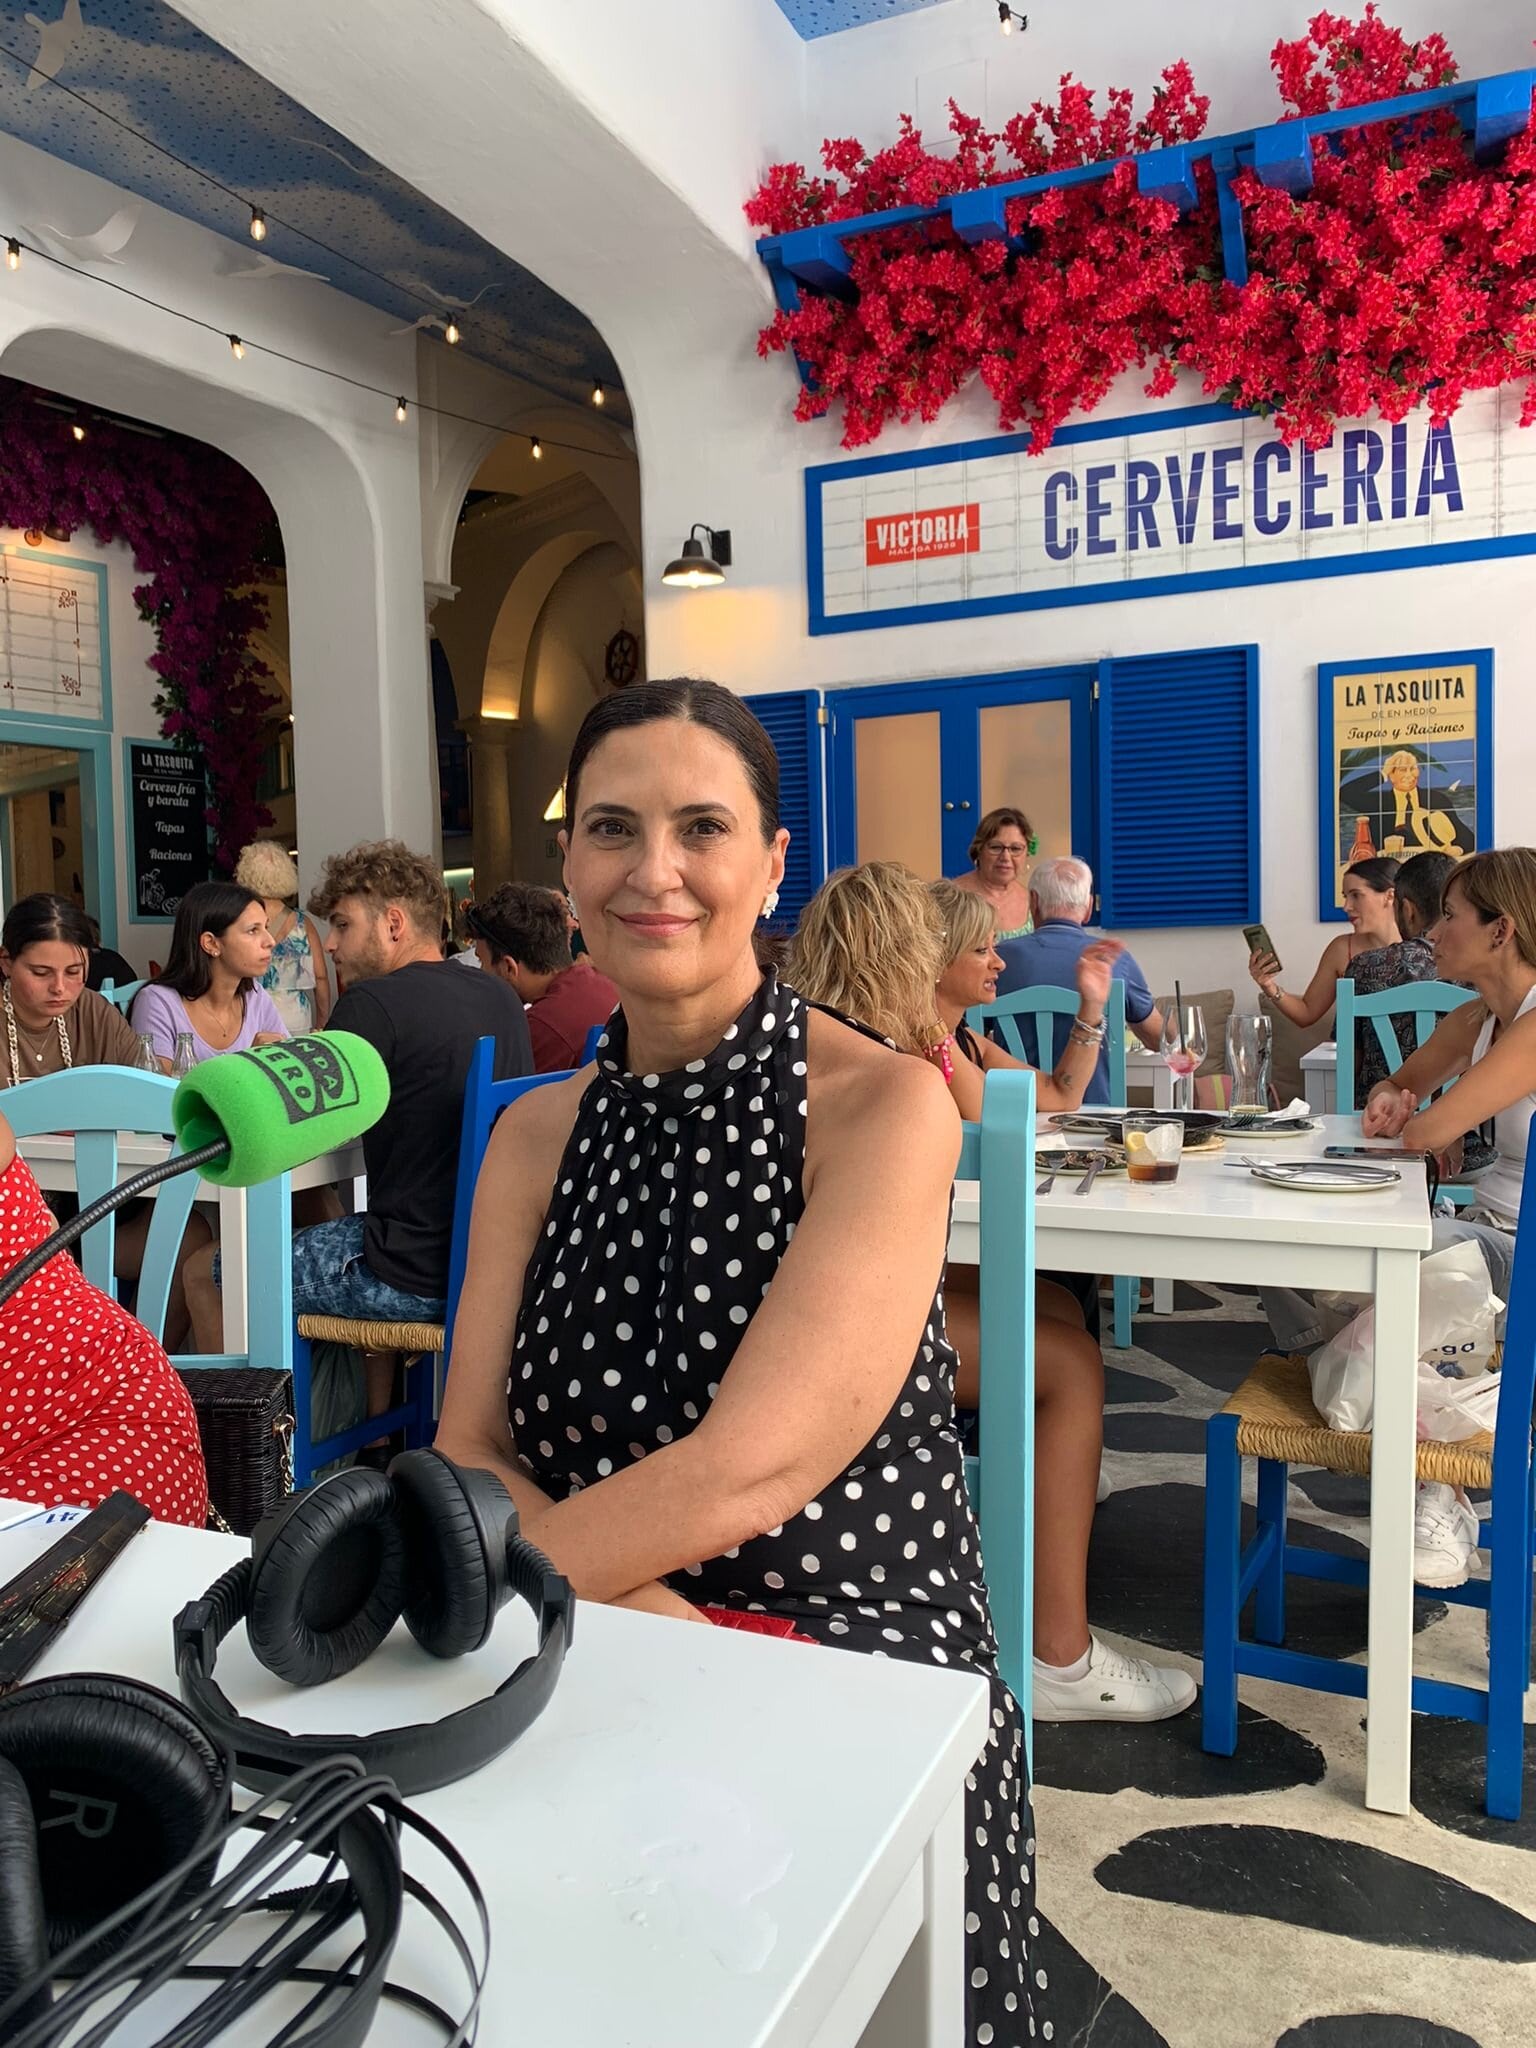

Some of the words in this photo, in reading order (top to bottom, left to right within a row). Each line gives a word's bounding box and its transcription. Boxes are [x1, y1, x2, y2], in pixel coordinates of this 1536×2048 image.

[876, 511, 969, 551] VICTORIA
[1345, 685, 1366, 707] LA
[1374, 677, 1465, 704] TASQUITA
[1371, 711, 1384, 719] DE
[1388, 710, 1400, 718] EN
[1405, 706, 1437, 717] MEDIO
[1347, 727, 1388, 742] Tapas
[1392, 728, 1402, 740] y
[1405, 723, 1465, 736] Raciones
[141, 753, 153, 767] LA
[153, 754, 194, 770] TASQUITA
[140, 779, 177, 793] Cerveza
[147, 796, 155, 808] y
[156, 795, 189, 807] barata
[155, 820, 185, 836] Tapas
[149, 848, 192, 861] Raciones
[254, 1046, 311, 1099] ERO
[40, 1788, 118, 1839] R
